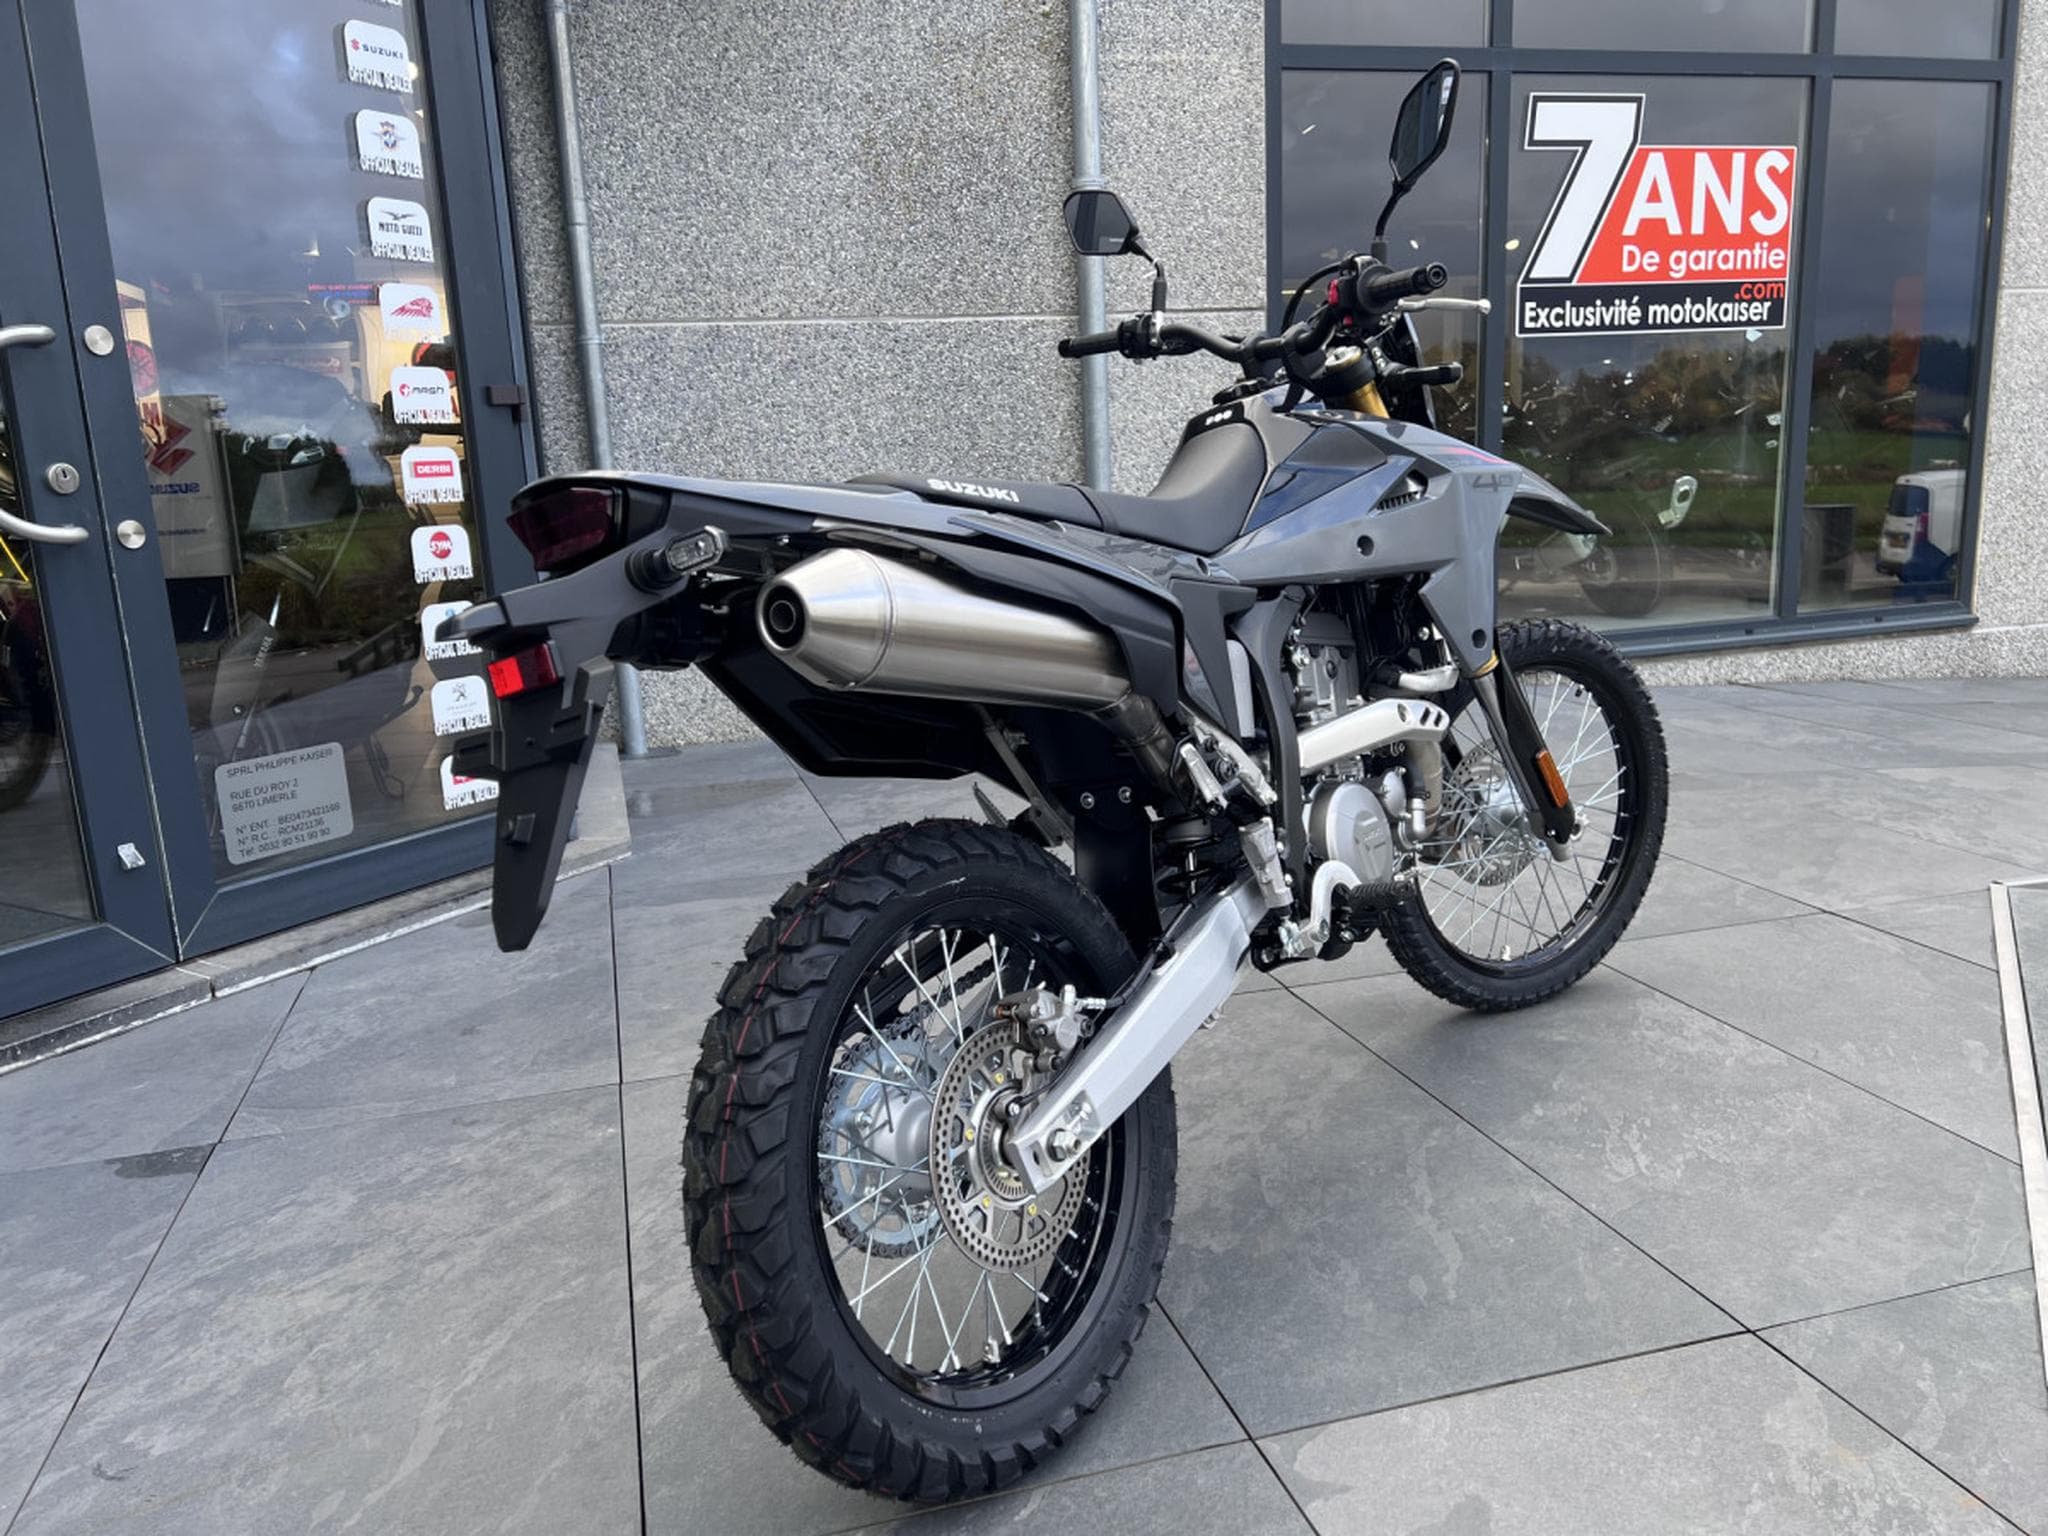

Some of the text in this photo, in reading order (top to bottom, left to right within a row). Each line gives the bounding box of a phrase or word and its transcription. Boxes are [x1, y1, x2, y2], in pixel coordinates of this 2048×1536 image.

[362, 44, 404, 59] SUZUKI
[1524, 94, 1790, 284] 7 ANS
[1621, 242, 1786, 278] De garantie
[1734, 281, 1785, 300] .com
[1524, 296, 1772, 328] Exclusivité motokaiser
[416, 464, 451, 474] DERBI
[926, 478, 1020, 503] SUZUKI
[255, 756, 297, 772] PHILIPPE
[300, 748, 333, 762] KAISER
[230, 788, 252, 801] RUE
[253, 784, 269, 796] DU
[270, 780, 290, 792] ROY
[256, 790, 298, 806] LIMERLE
